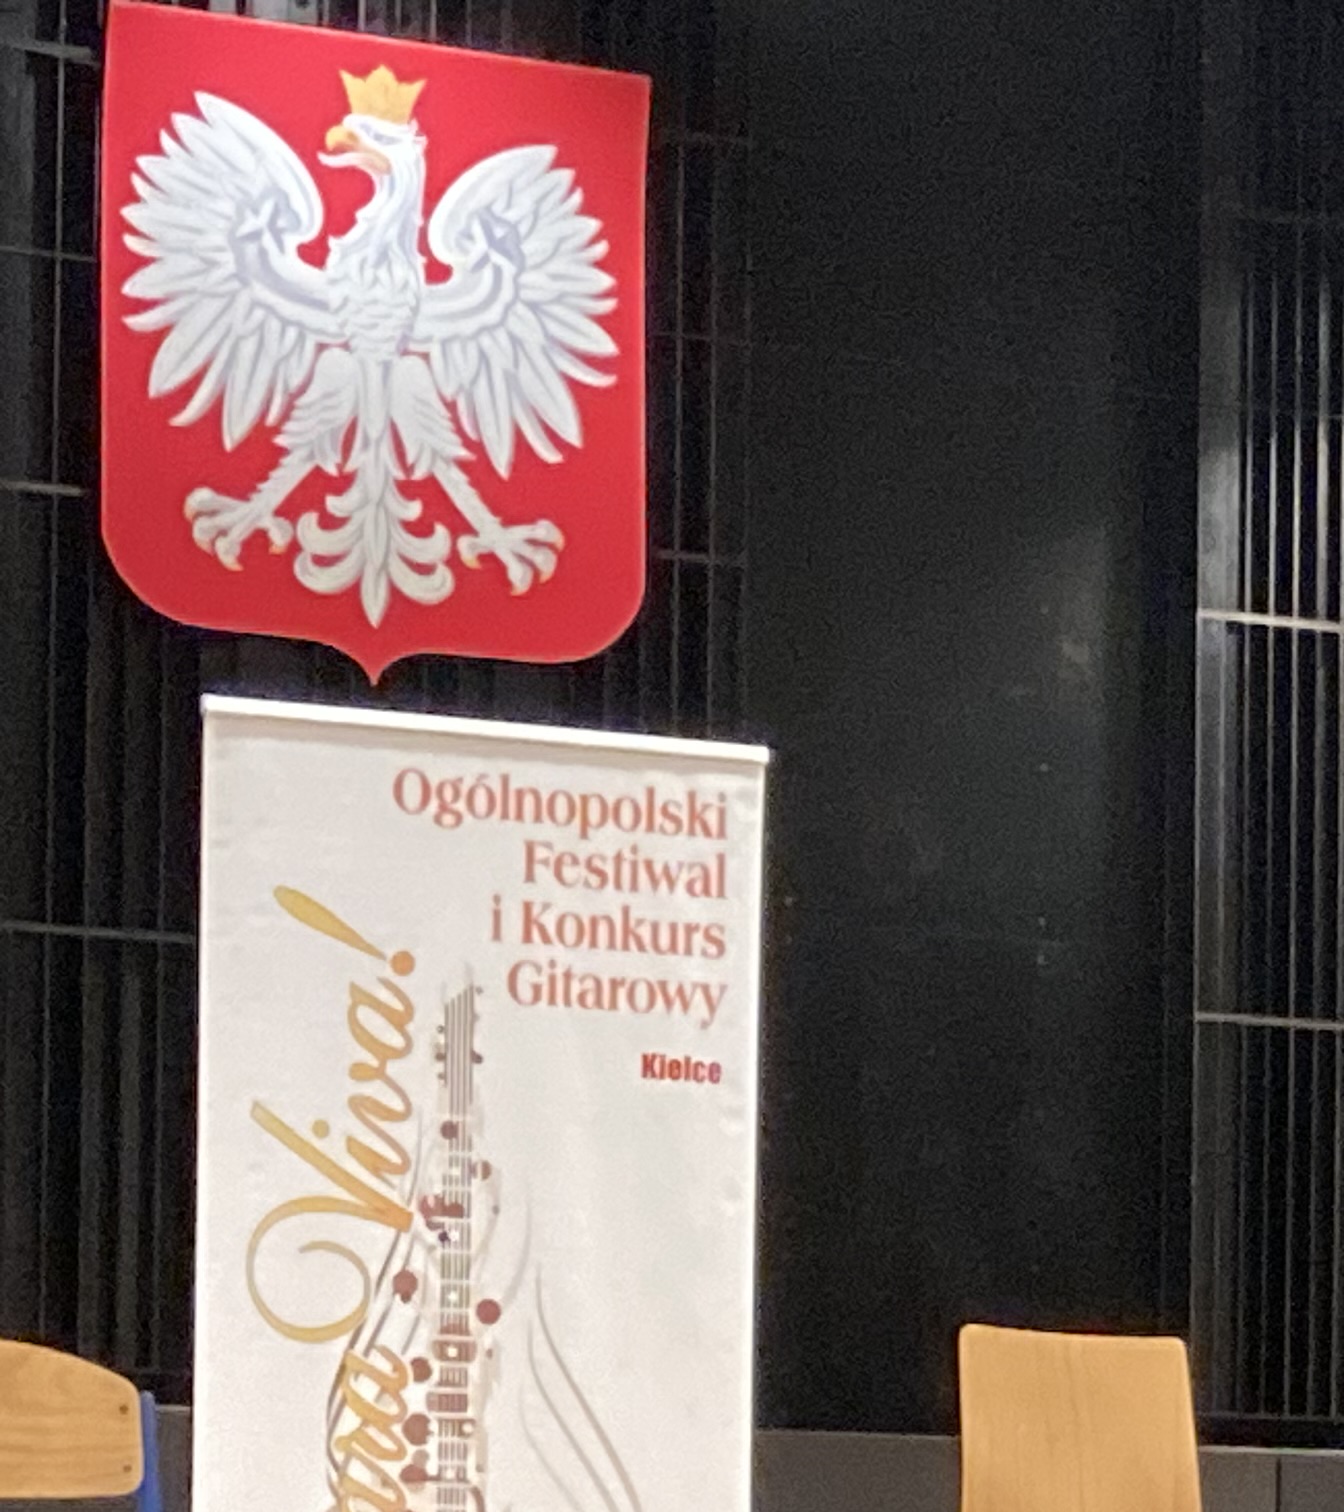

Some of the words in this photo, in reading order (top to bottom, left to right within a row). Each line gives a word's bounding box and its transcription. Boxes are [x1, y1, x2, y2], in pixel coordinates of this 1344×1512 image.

[393, 768, 727, 840] Ogólnopolski
[522, 840, 727, 899] Festiwal
[491, 894, 503, 942] i
[521, 899, 727, 959] Konkurs
[507, 960, 728, 1030] Gitarowy
[640, 1052, 723, 1085] Kielce
[246, 885, 416, 1343] Viva!
